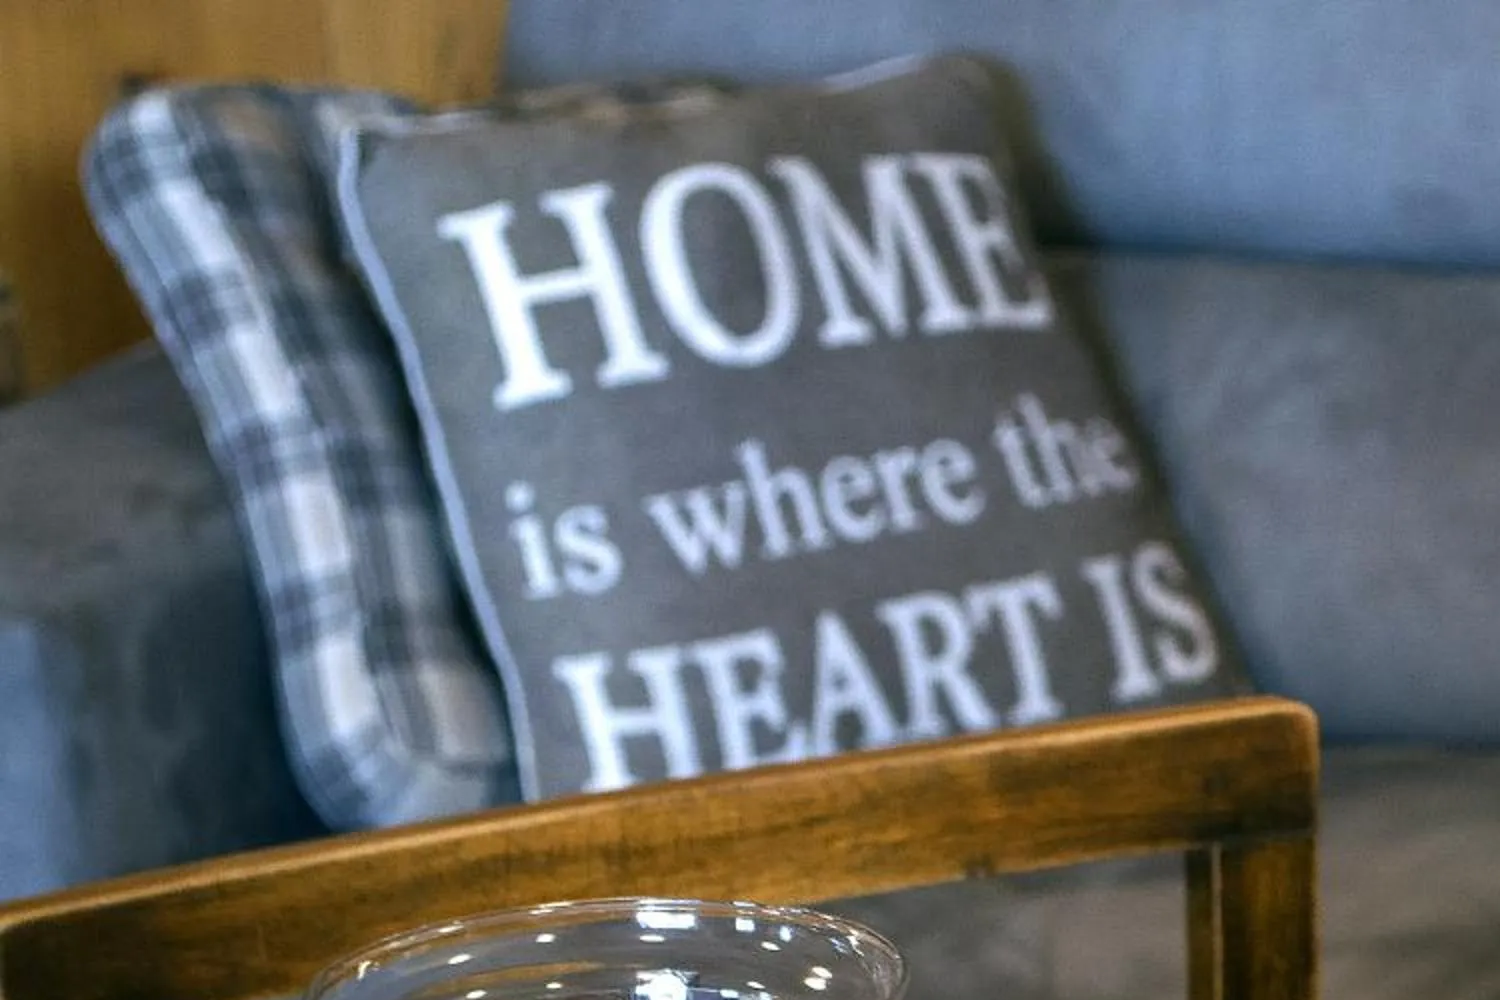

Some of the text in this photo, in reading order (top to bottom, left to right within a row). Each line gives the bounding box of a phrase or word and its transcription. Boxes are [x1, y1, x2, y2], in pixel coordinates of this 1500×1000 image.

[438, 152, 1053, 410] HOME
[506, 394, 1136, 600] is where the
[552, 542, 1218, 794] HEART IS
